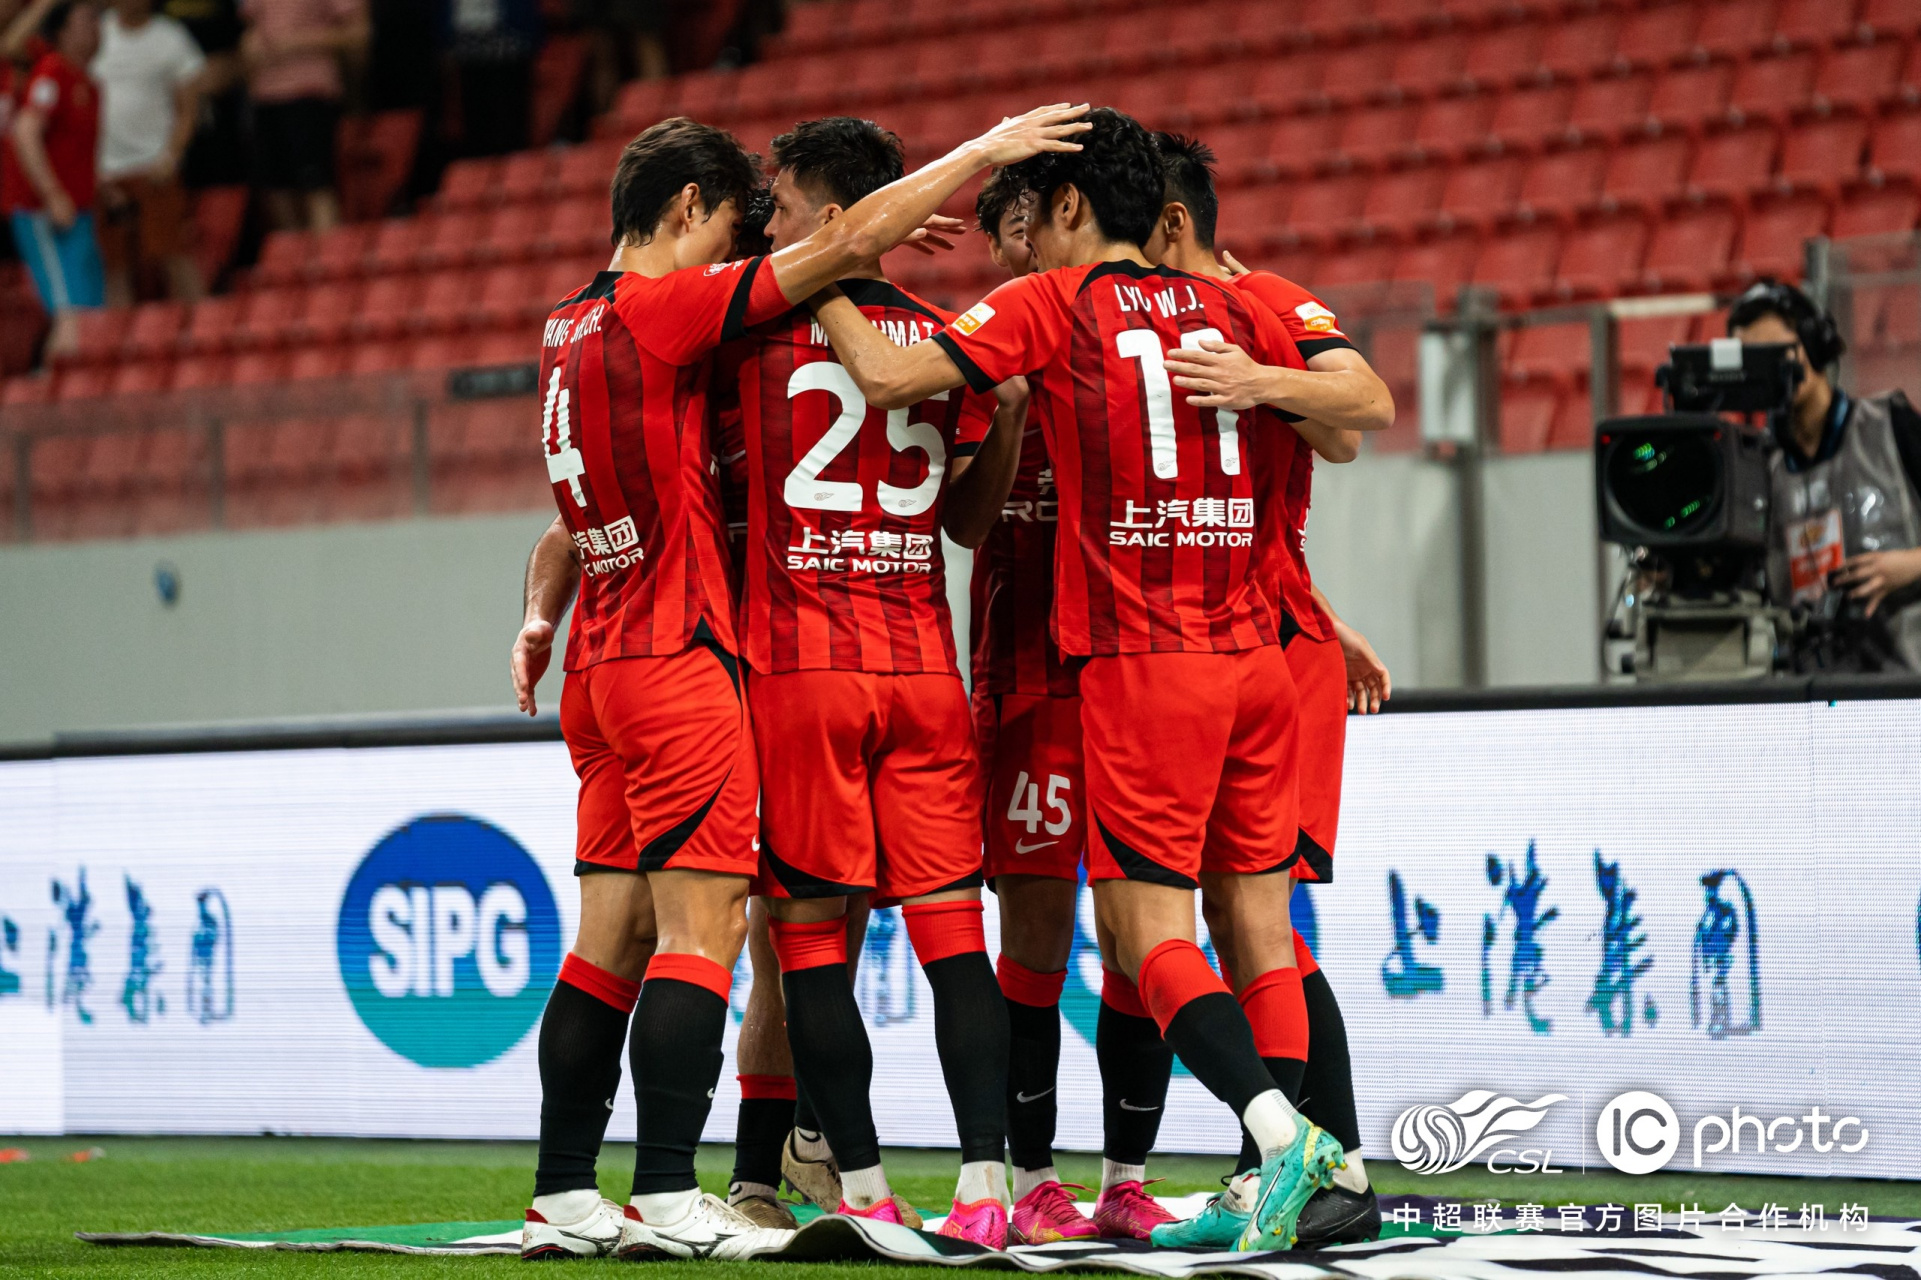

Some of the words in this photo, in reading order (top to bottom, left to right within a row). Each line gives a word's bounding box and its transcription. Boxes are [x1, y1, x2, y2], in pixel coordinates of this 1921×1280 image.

[1153, 284, 1205, 319] W.J.
[1116, 328, 1241, 479] 11
[541, 367, 587, 508] 4
[783, 361, 949, 517] 25
[1110, 498, 1255, 529] 上汽集团
[571, 515, 640, 560] 汽集团
[787, 527, 934, 560] 上汽集团
[1109, 531, 1170, 547] SAIC
[1176, 532, 1253, 547] MOTOR
[592, 547, 645, 575] MOTOR
[787, 555, 845, 572] SAIC
[852, 558, 932, 574] MOTOR
[1007, 771, 1072, 836] 45
[368, 883, 532, 998] SIPG
